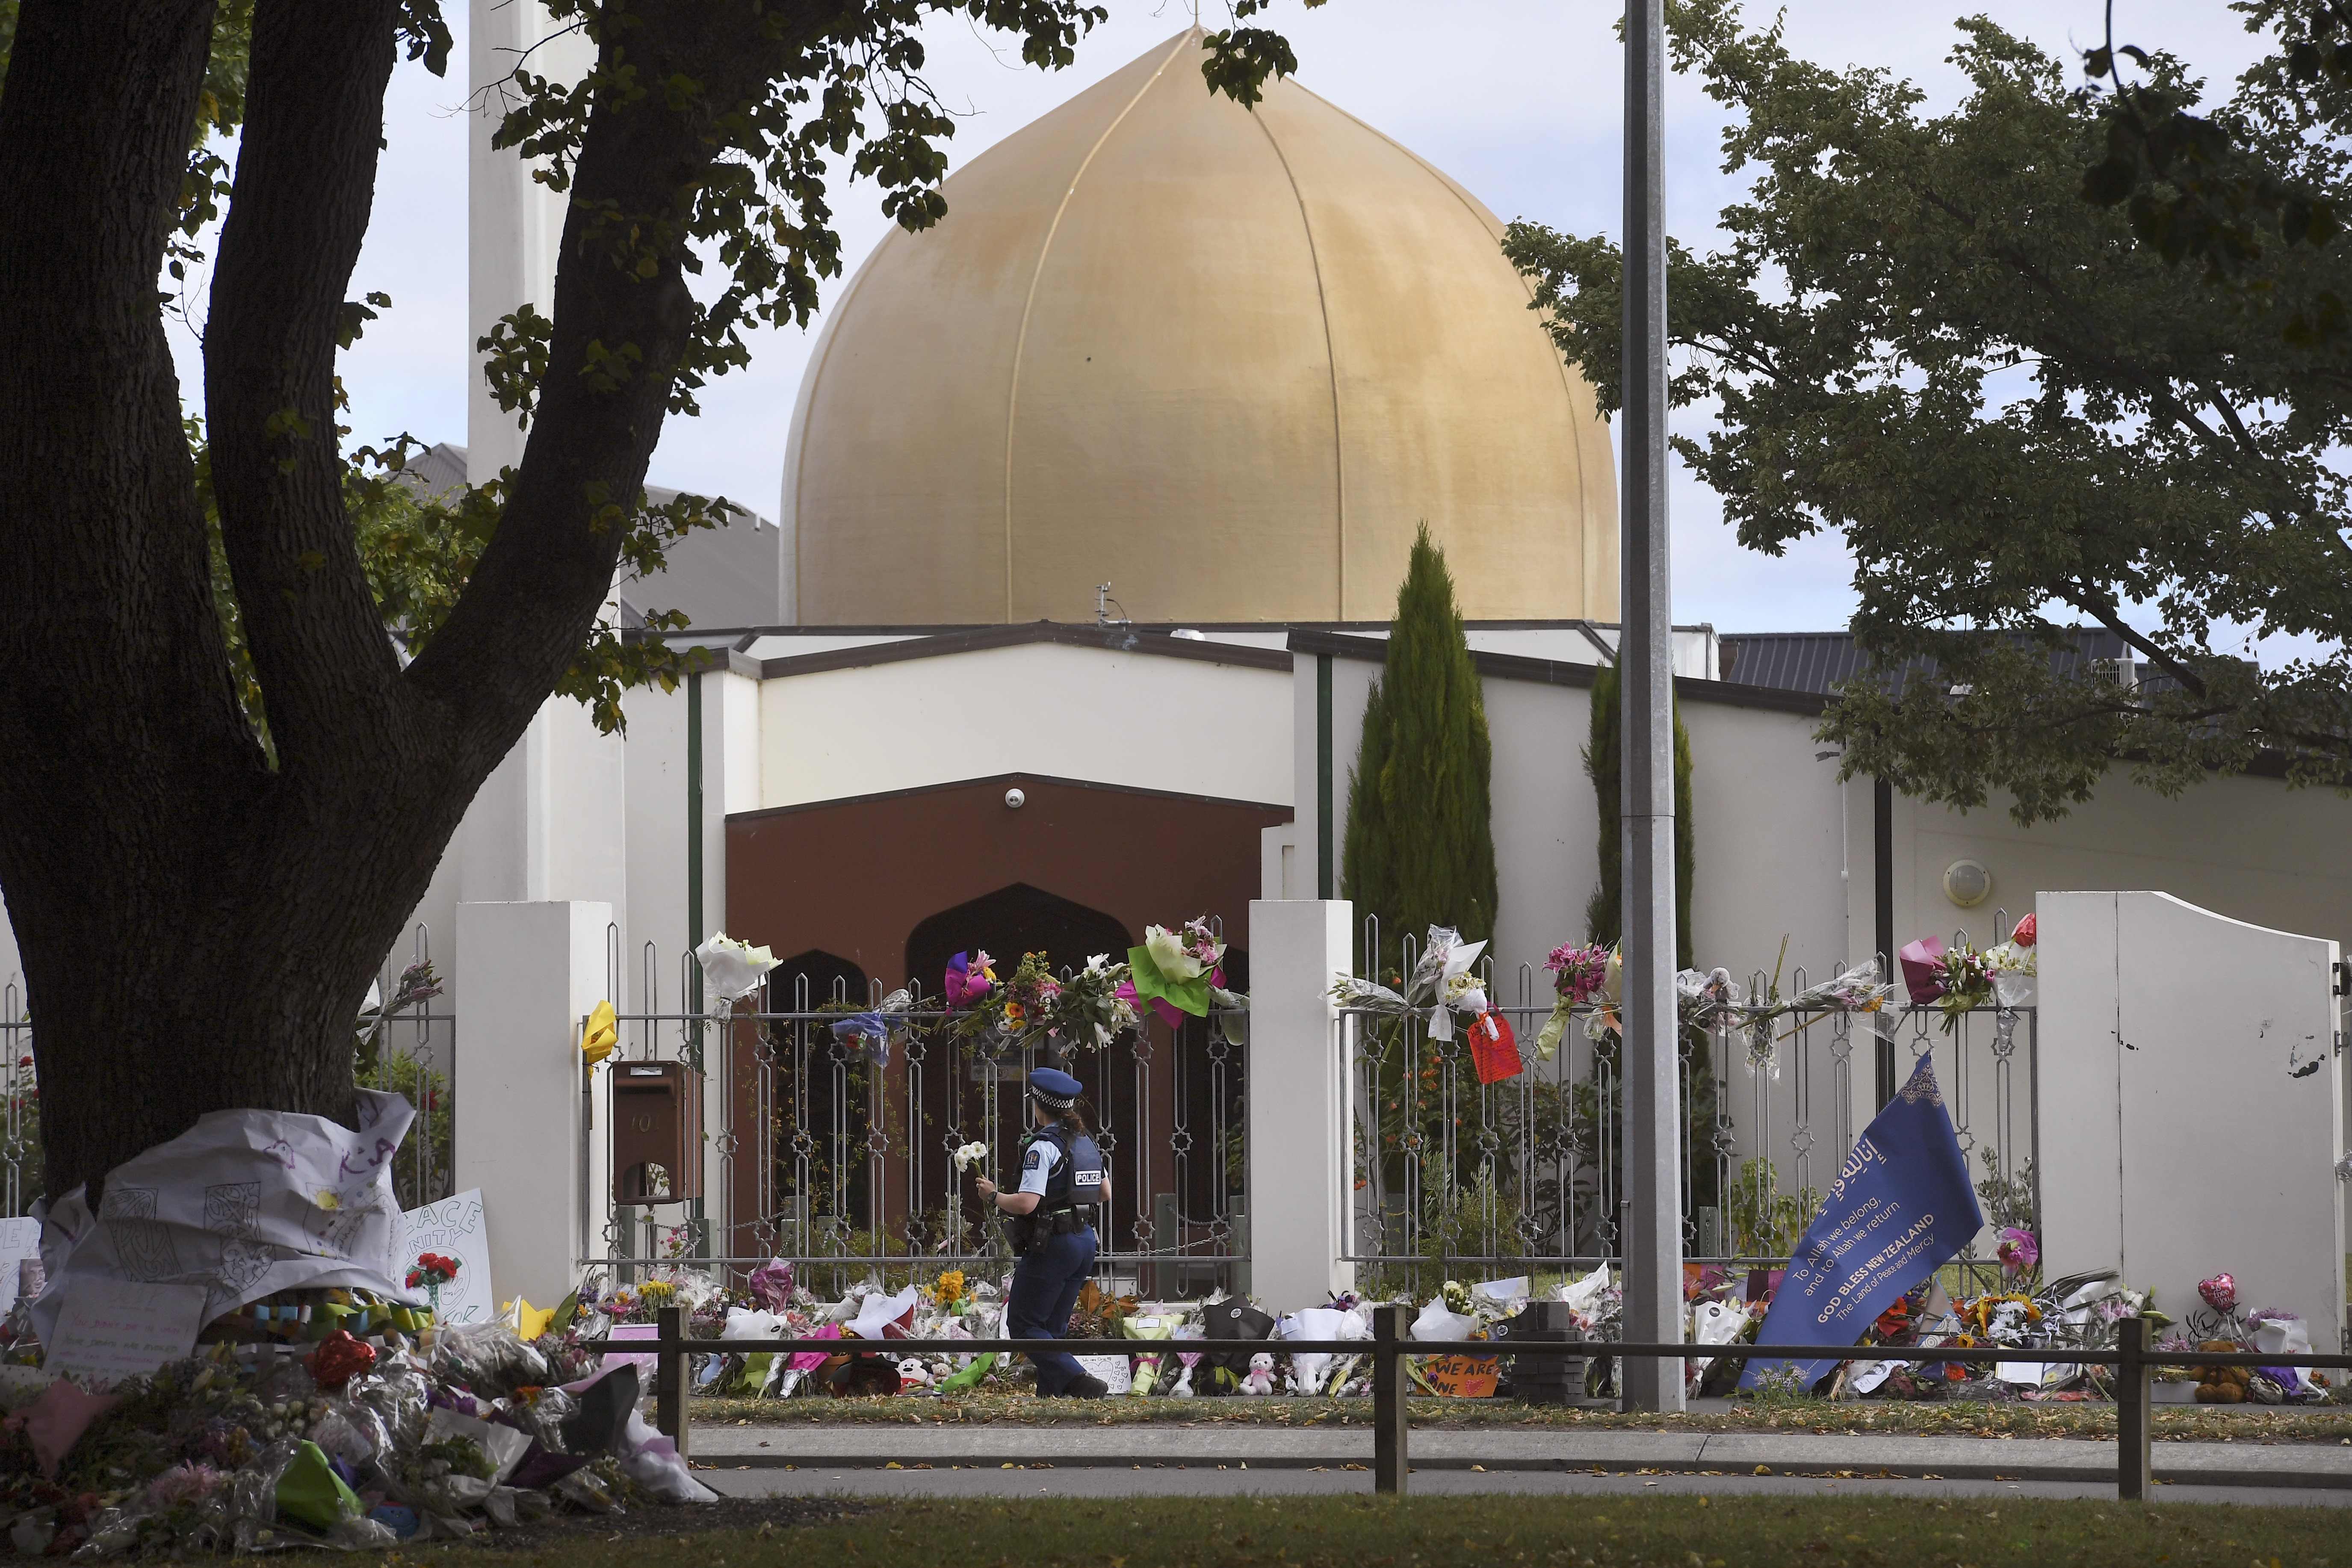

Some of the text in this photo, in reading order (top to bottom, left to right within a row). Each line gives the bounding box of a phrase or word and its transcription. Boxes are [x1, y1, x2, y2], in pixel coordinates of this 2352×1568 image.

[1077, 1173, 1099, 1182] POLICE
[1792, 1269, 1809, 1281] To
[1807, 1239, 1831, 1268] Allah
[1827, 1228, 1843, 1241] we
[1841, 1197, 1881, 1230] belong,
[1804, 1202, 1900, 1296] and to Allah we return
[1817, 1214, 1934, 1323] GOD BLESS NEW ZEALAND
[1836, 1233, 1935, 1321] The Land of Peace and Mercy
[2213, 1289, 2229, 1298] Love
[1435, 1361, 1495, 1376] WE ARE
